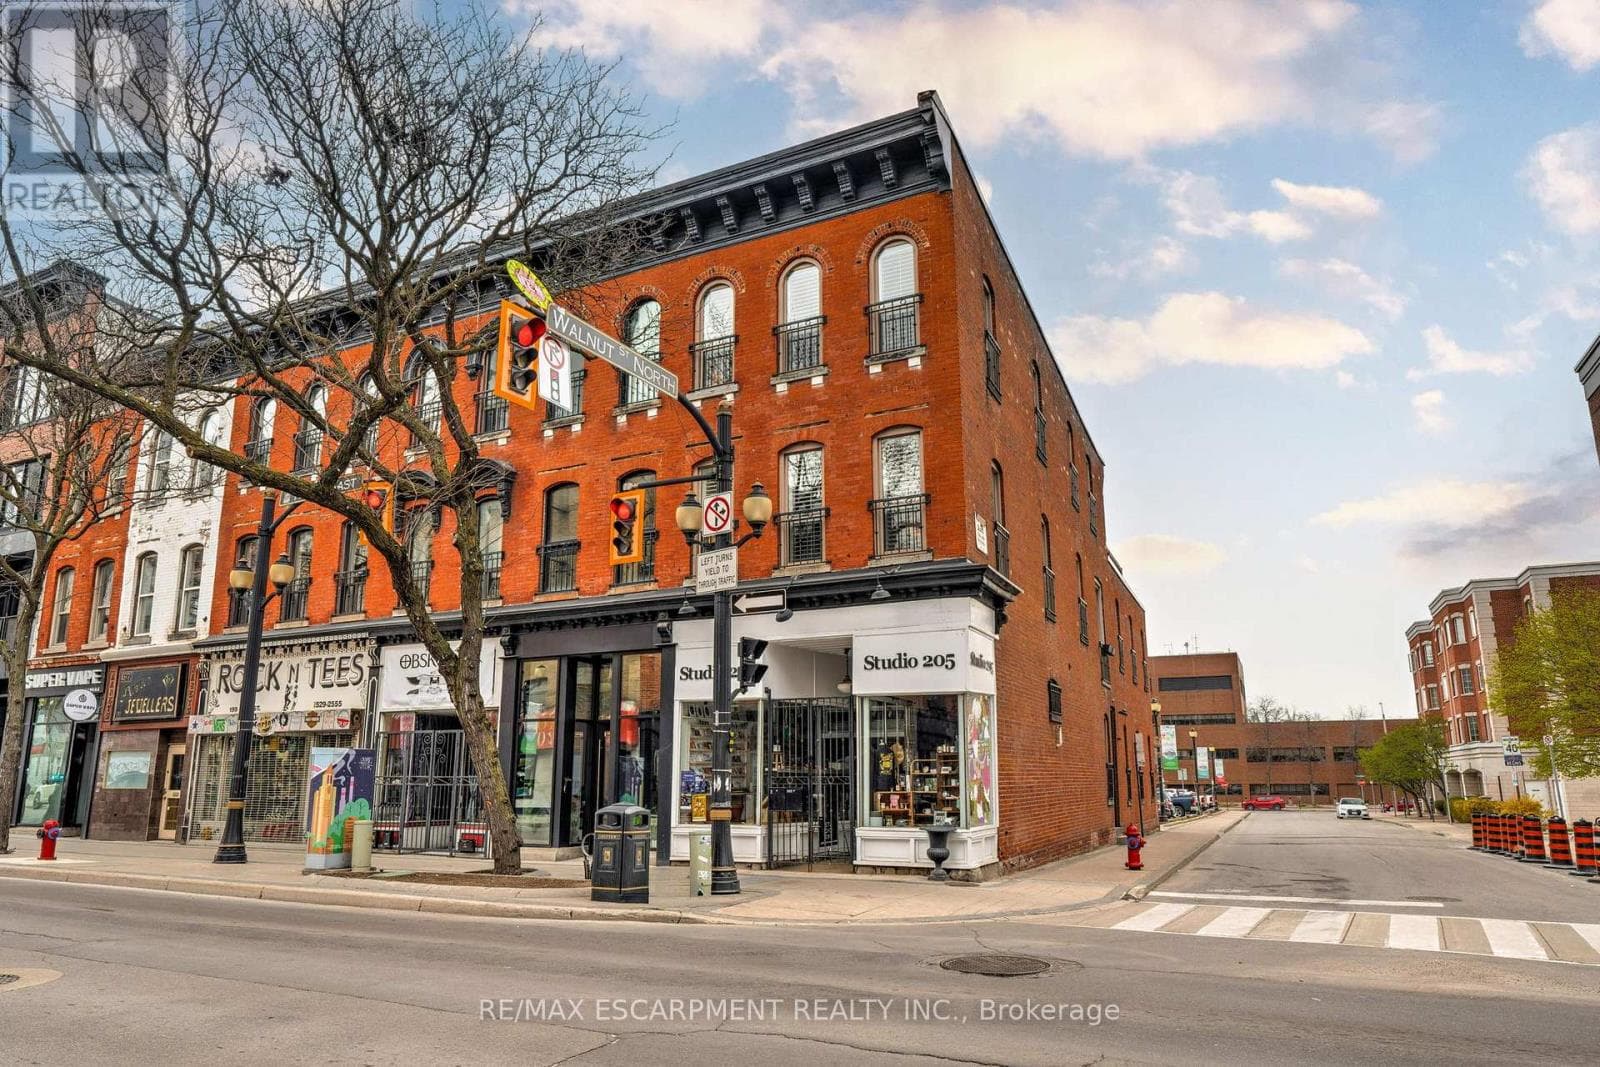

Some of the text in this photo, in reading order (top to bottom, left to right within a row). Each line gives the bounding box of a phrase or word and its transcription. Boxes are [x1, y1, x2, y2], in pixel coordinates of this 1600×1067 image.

[553, 309, 614, 358] WALNUT
[633, 357, 675, 393] NORTH
[701, 553, 733, 566] LEFT TURNS
[705, 564, 729, 576] YIELD TO
[698, 575, 735, 588] THROUGH TRAFFIC
[864, 653, 955, 670] Studio 205
[307, 653, 364, 688] TEES
[680, 665, 715, 680] Stud
[25, 673, 66, 689] SUPER
[67, 669, 103, 686] VAPE
[1506, 744, 1518, 753] 40
